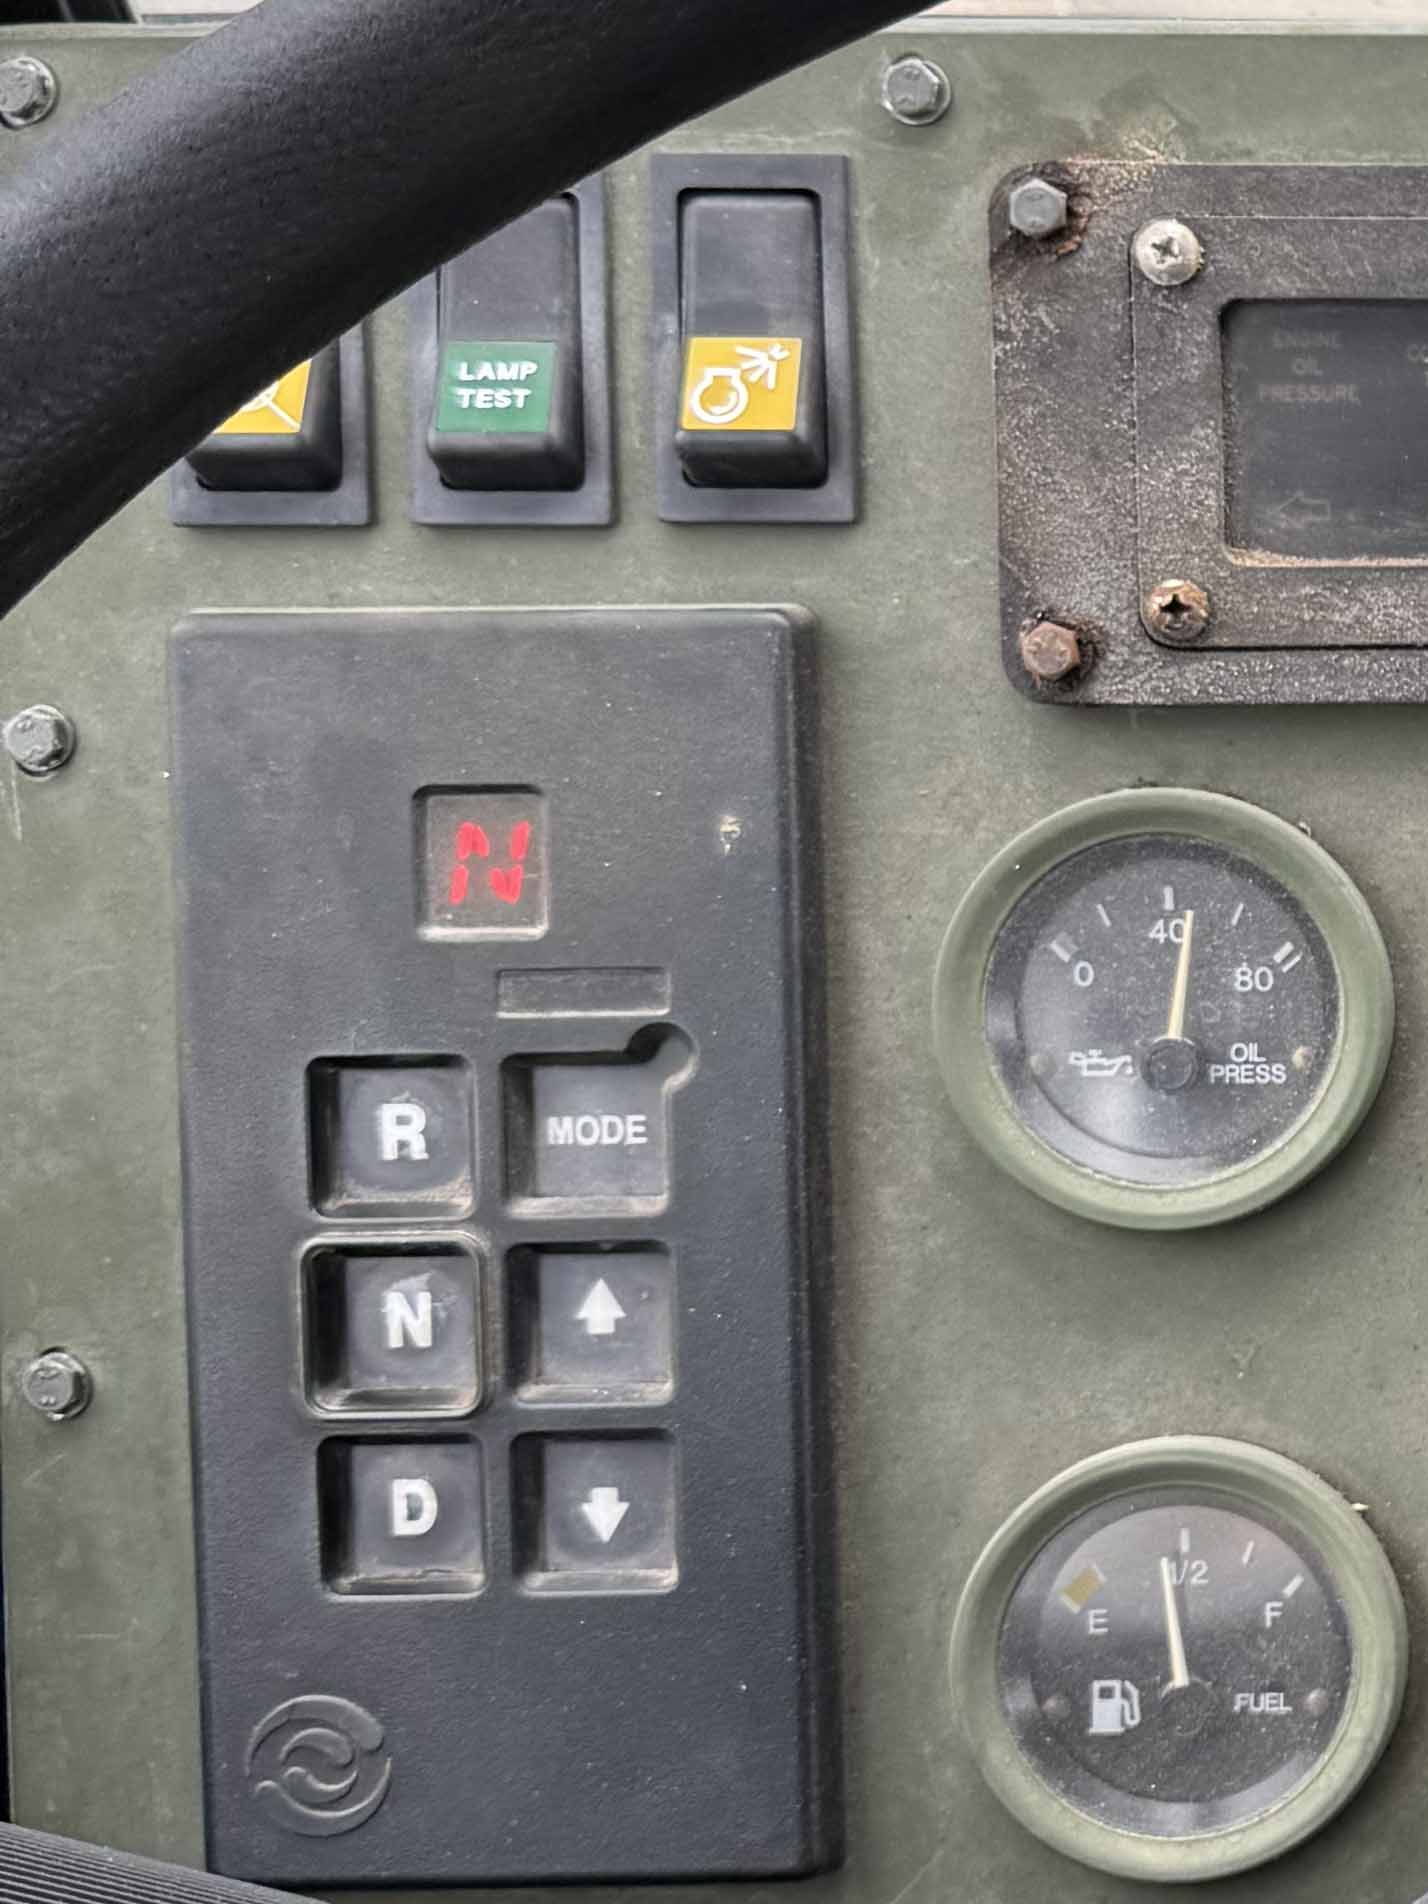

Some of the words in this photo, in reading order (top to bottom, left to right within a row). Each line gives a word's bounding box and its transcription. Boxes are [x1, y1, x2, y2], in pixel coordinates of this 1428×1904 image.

[457, 359, 539, 383] LAMP
[455, 387, 532, 410] TEST
[447, 821, 532, 904] N
[1148, 918, 1189, 944] 40
[1073, 962, 1094, 988] 0
[1233, 966, 1275, 992] 80
[1229, 1042, 1267, 1063] OIL
[1209, 1063, 1287, 1085] PRESS
[379, 1101, 430, 1162] R
[546, 1114, 648, 1146] MODE
[382, 1290, 433, 1349] N
[391, 1478, 439, 1536] D
[1088, 1609, 1110, 1635] E
[1263, 1601, 1284, 1628] F
[1233, 1693, 1292, 1714] FUEL
